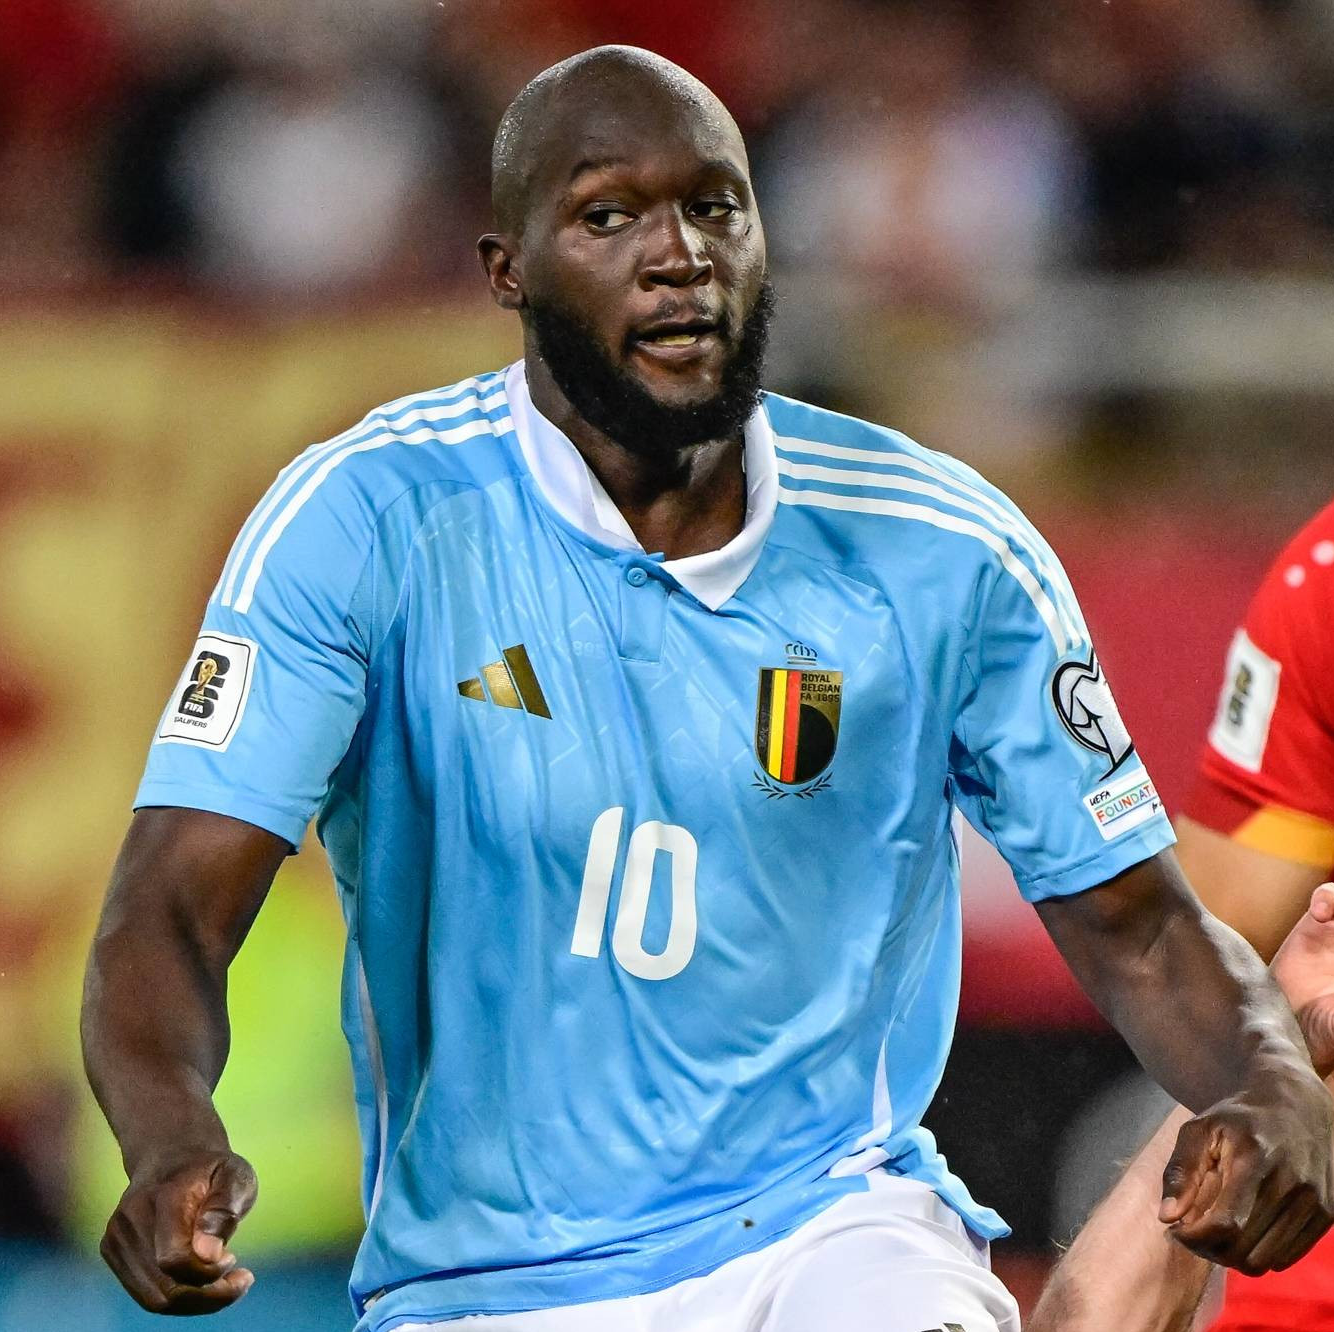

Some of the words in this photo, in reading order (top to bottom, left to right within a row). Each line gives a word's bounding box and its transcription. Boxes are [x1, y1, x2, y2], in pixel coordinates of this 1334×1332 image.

[800, 673, 831, 683] ROYAL
[800, 683, 841, 693] BELGIAN
[799, 692, 812, 701] FA
[817, 693, 840, 703] 1895
[183, 701, 204, 714] FIFA
[1089, 790, 1111, 806] UEFA
[570, 806, 698, 981] 10
